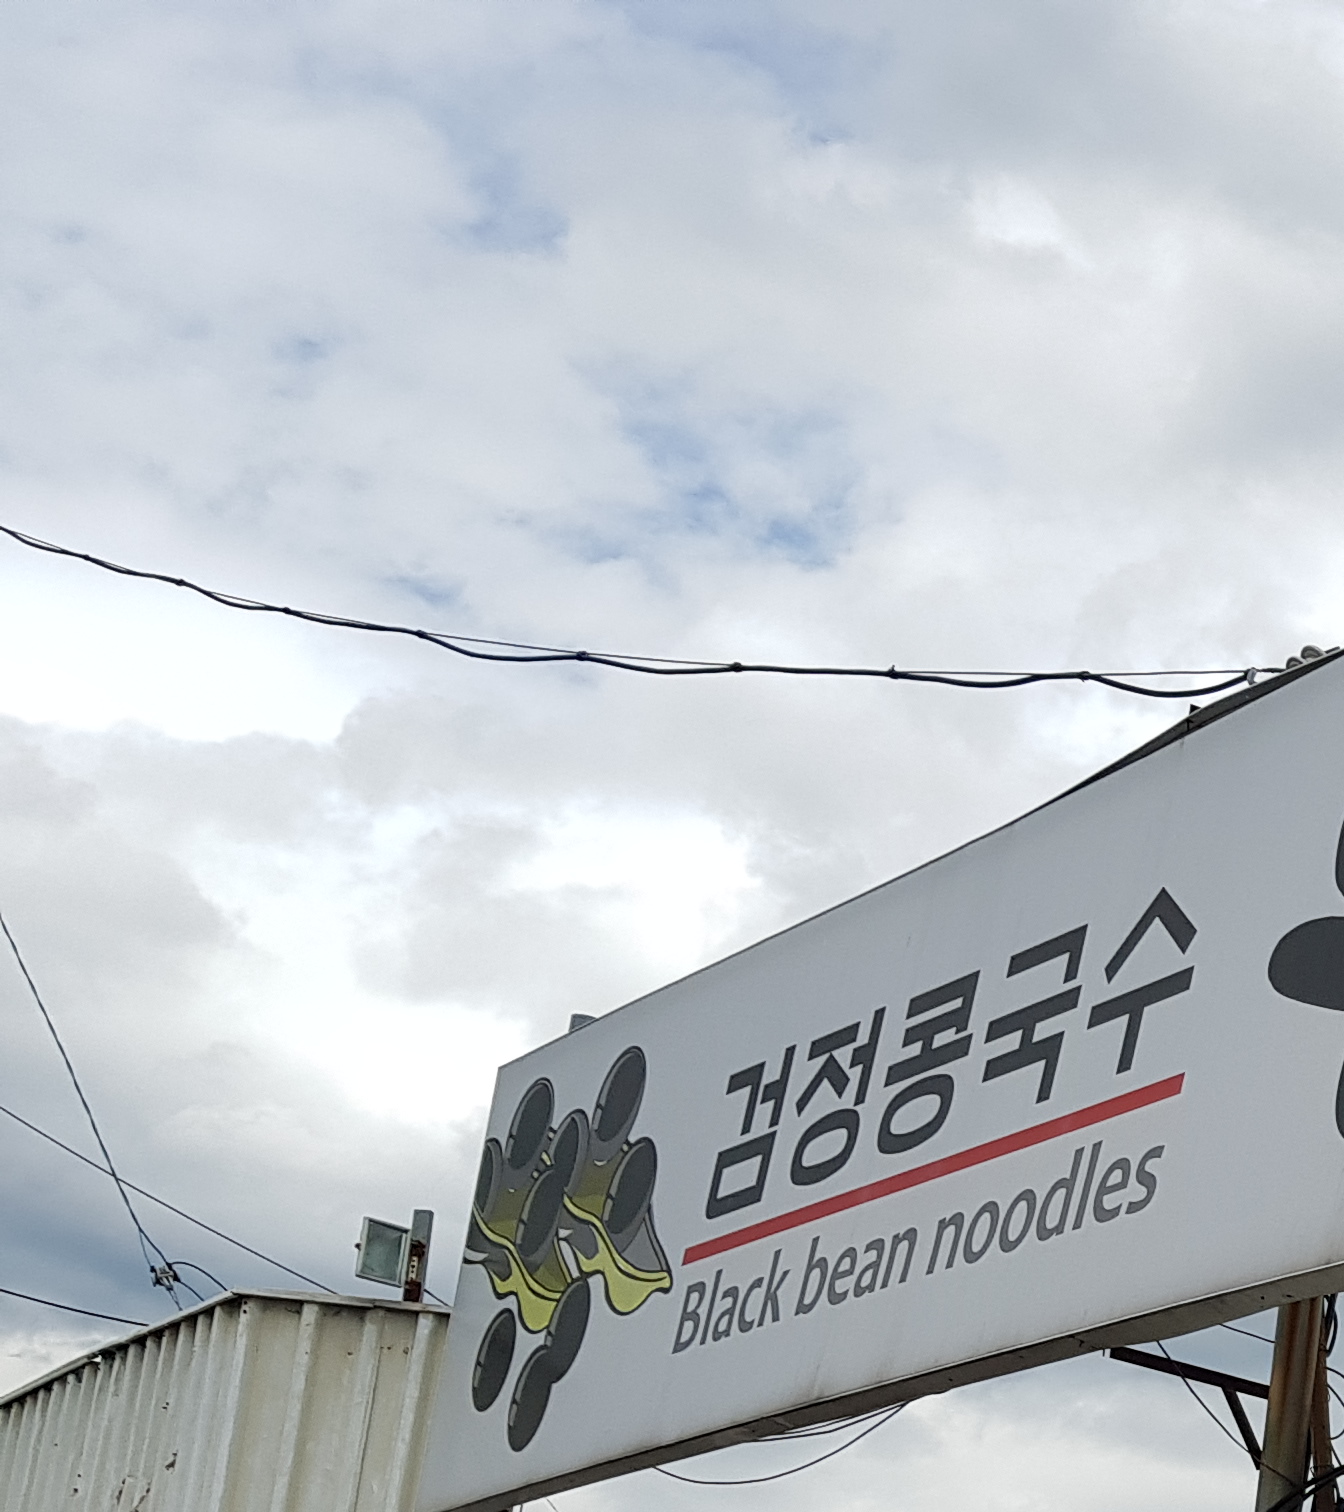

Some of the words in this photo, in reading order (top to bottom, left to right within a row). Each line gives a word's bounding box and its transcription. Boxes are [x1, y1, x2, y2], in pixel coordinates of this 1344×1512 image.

[705, 887, 1198, 1220] 검정콩국수
[671, 1248, 790, 1355] Black
[795, 1225, 918, 1318] bean
[926, 1140, 1165, 1276] noodles
